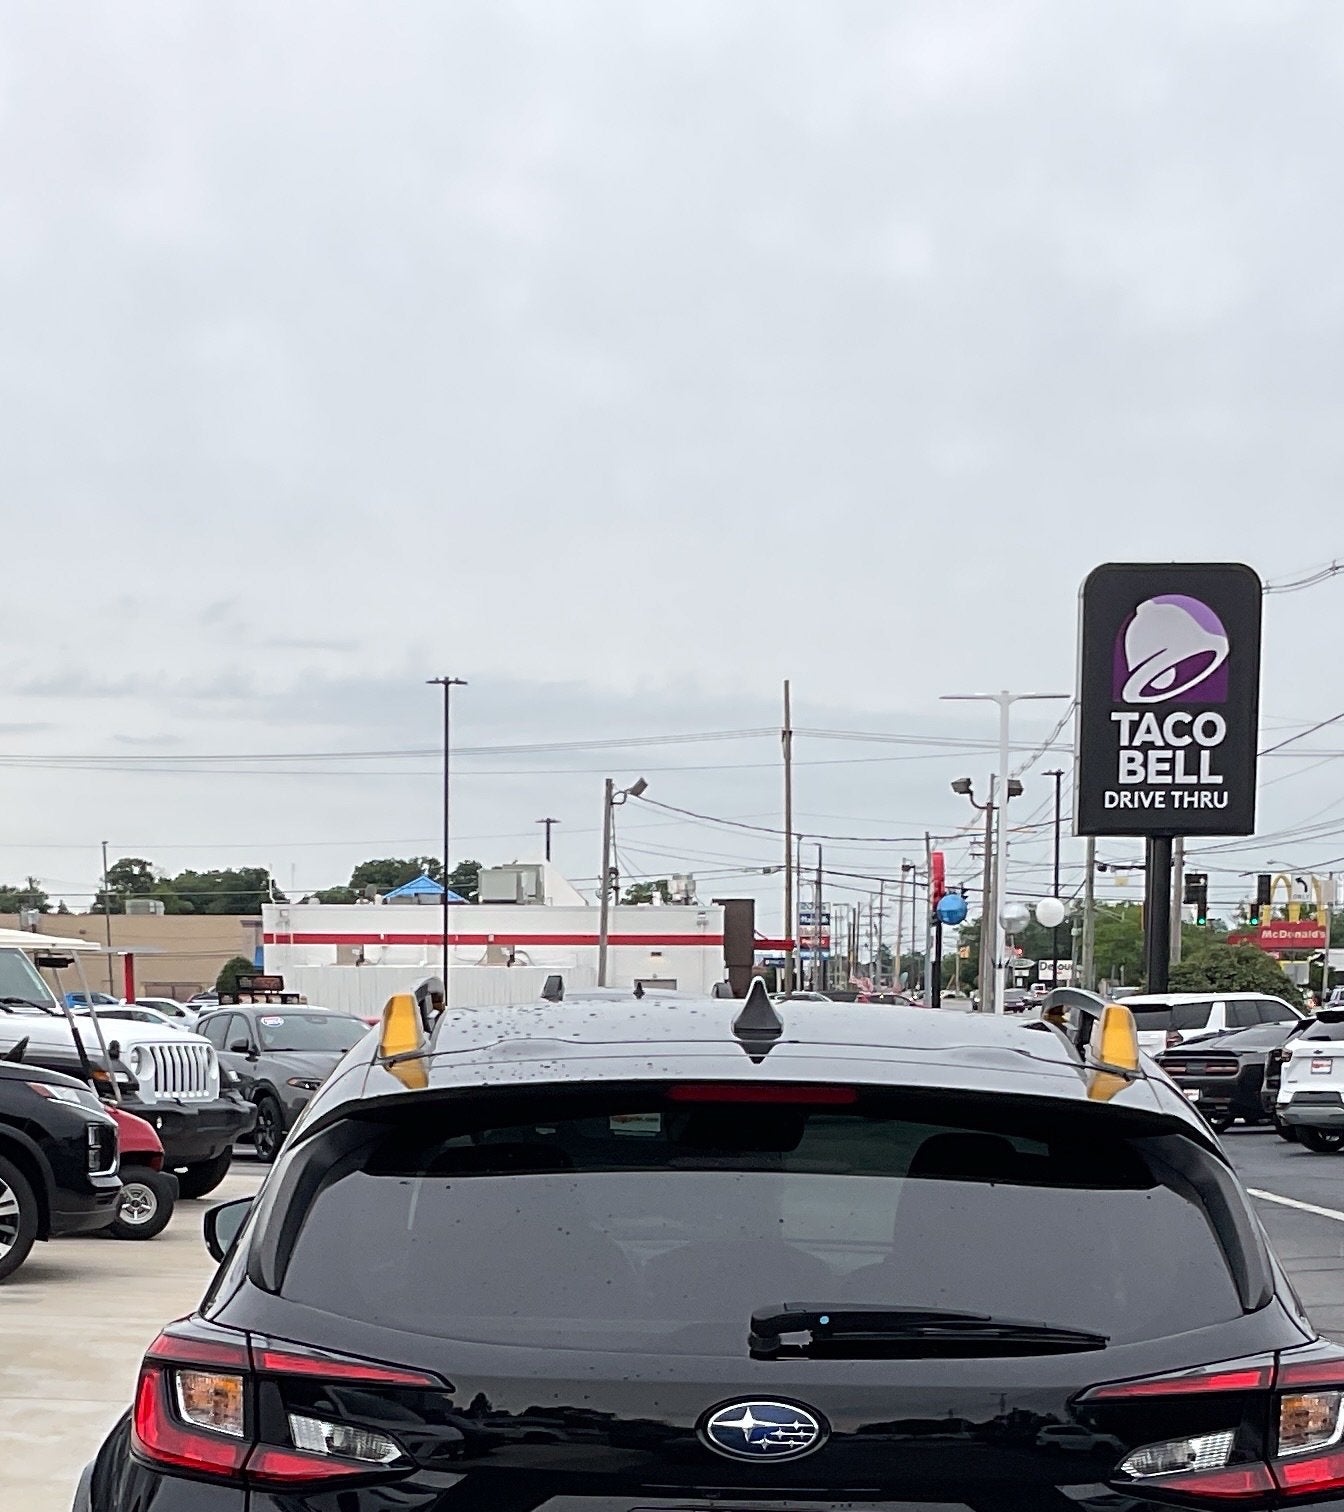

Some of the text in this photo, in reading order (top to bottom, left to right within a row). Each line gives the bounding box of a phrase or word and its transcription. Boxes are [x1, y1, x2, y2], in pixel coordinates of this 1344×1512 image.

[1110, 711, 1227, 747] TACO
[1117, 749, 1224, 785] BELL
[1104, 791, 1229, 809] DRIVE THRU
[1260, 929, 1327, 940] McDonald's
